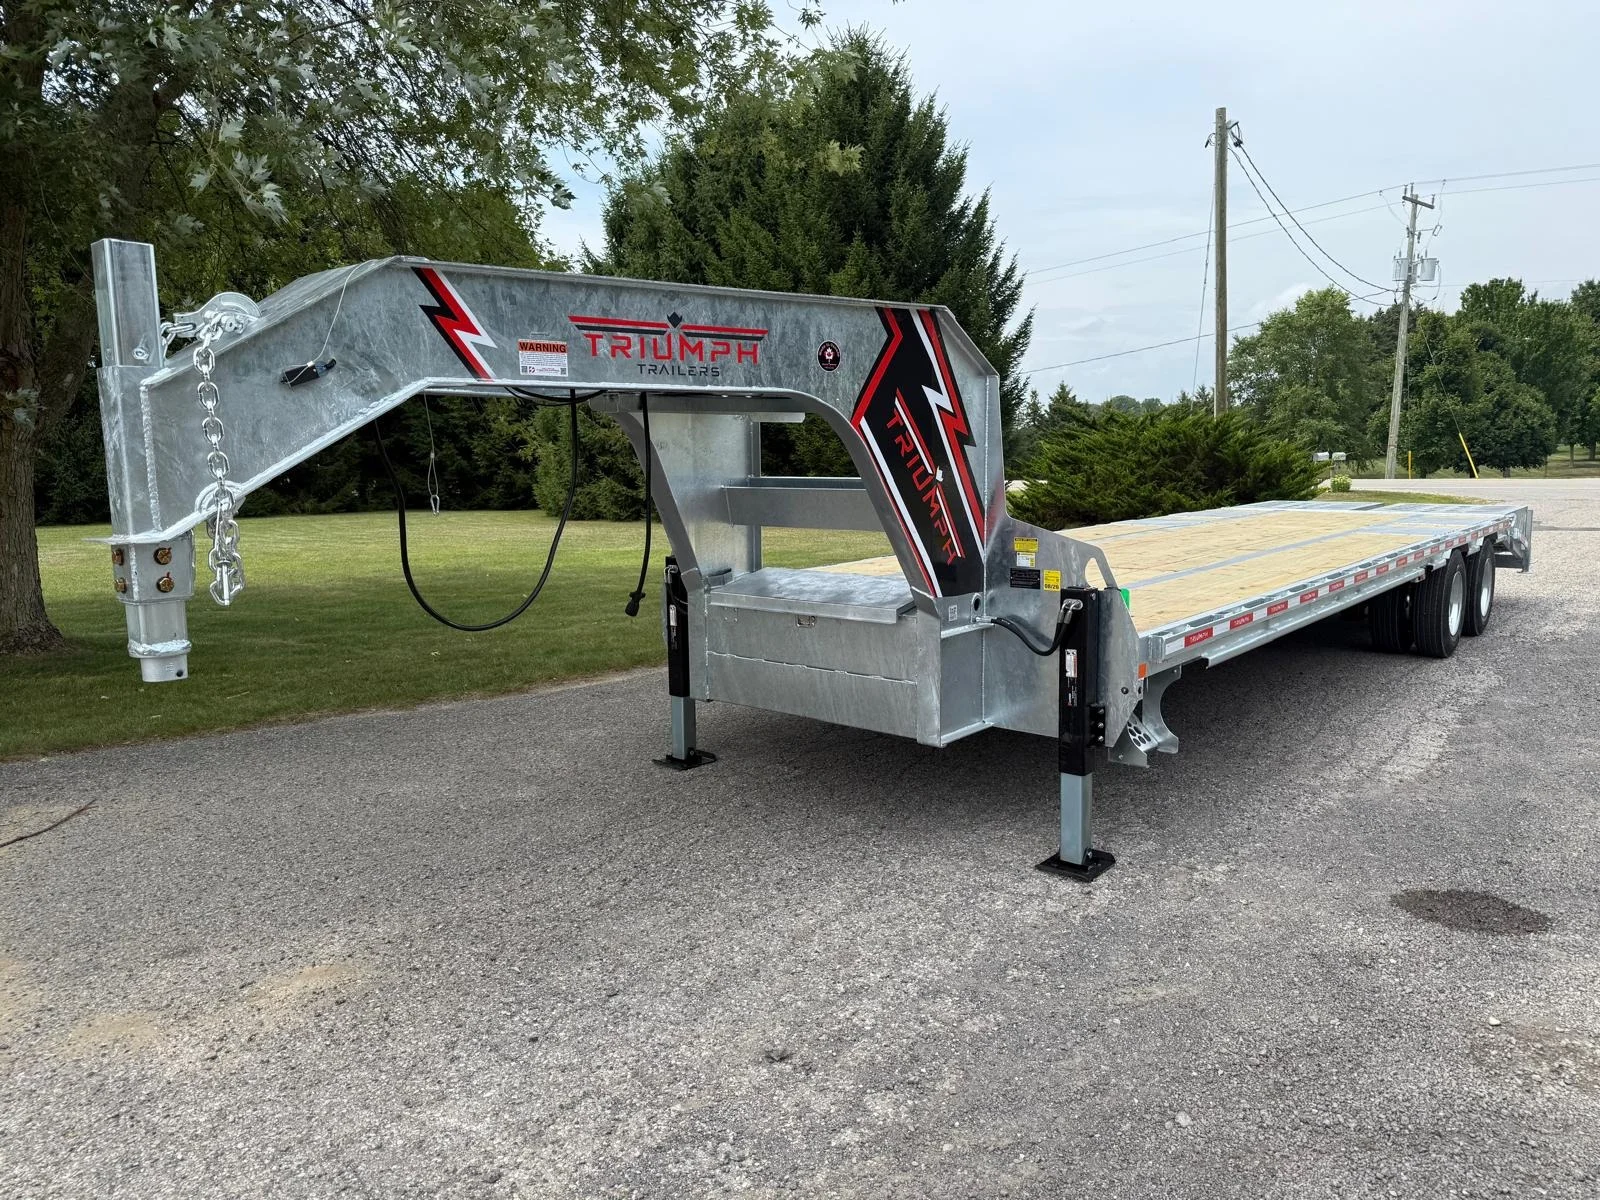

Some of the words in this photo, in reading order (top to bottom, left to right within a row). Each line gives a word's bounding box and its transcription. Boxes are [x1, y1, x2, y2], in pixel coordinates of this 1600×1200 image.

[518, 341, 567, 353] WARNING
[583, 333, 759, 365] TRIUMPH
[637, 363, 721, 377] TRAILERS
[886, 408, 957, 566] TRIUMPH
[1189, 631, 1209, 643] TRIUMPH
